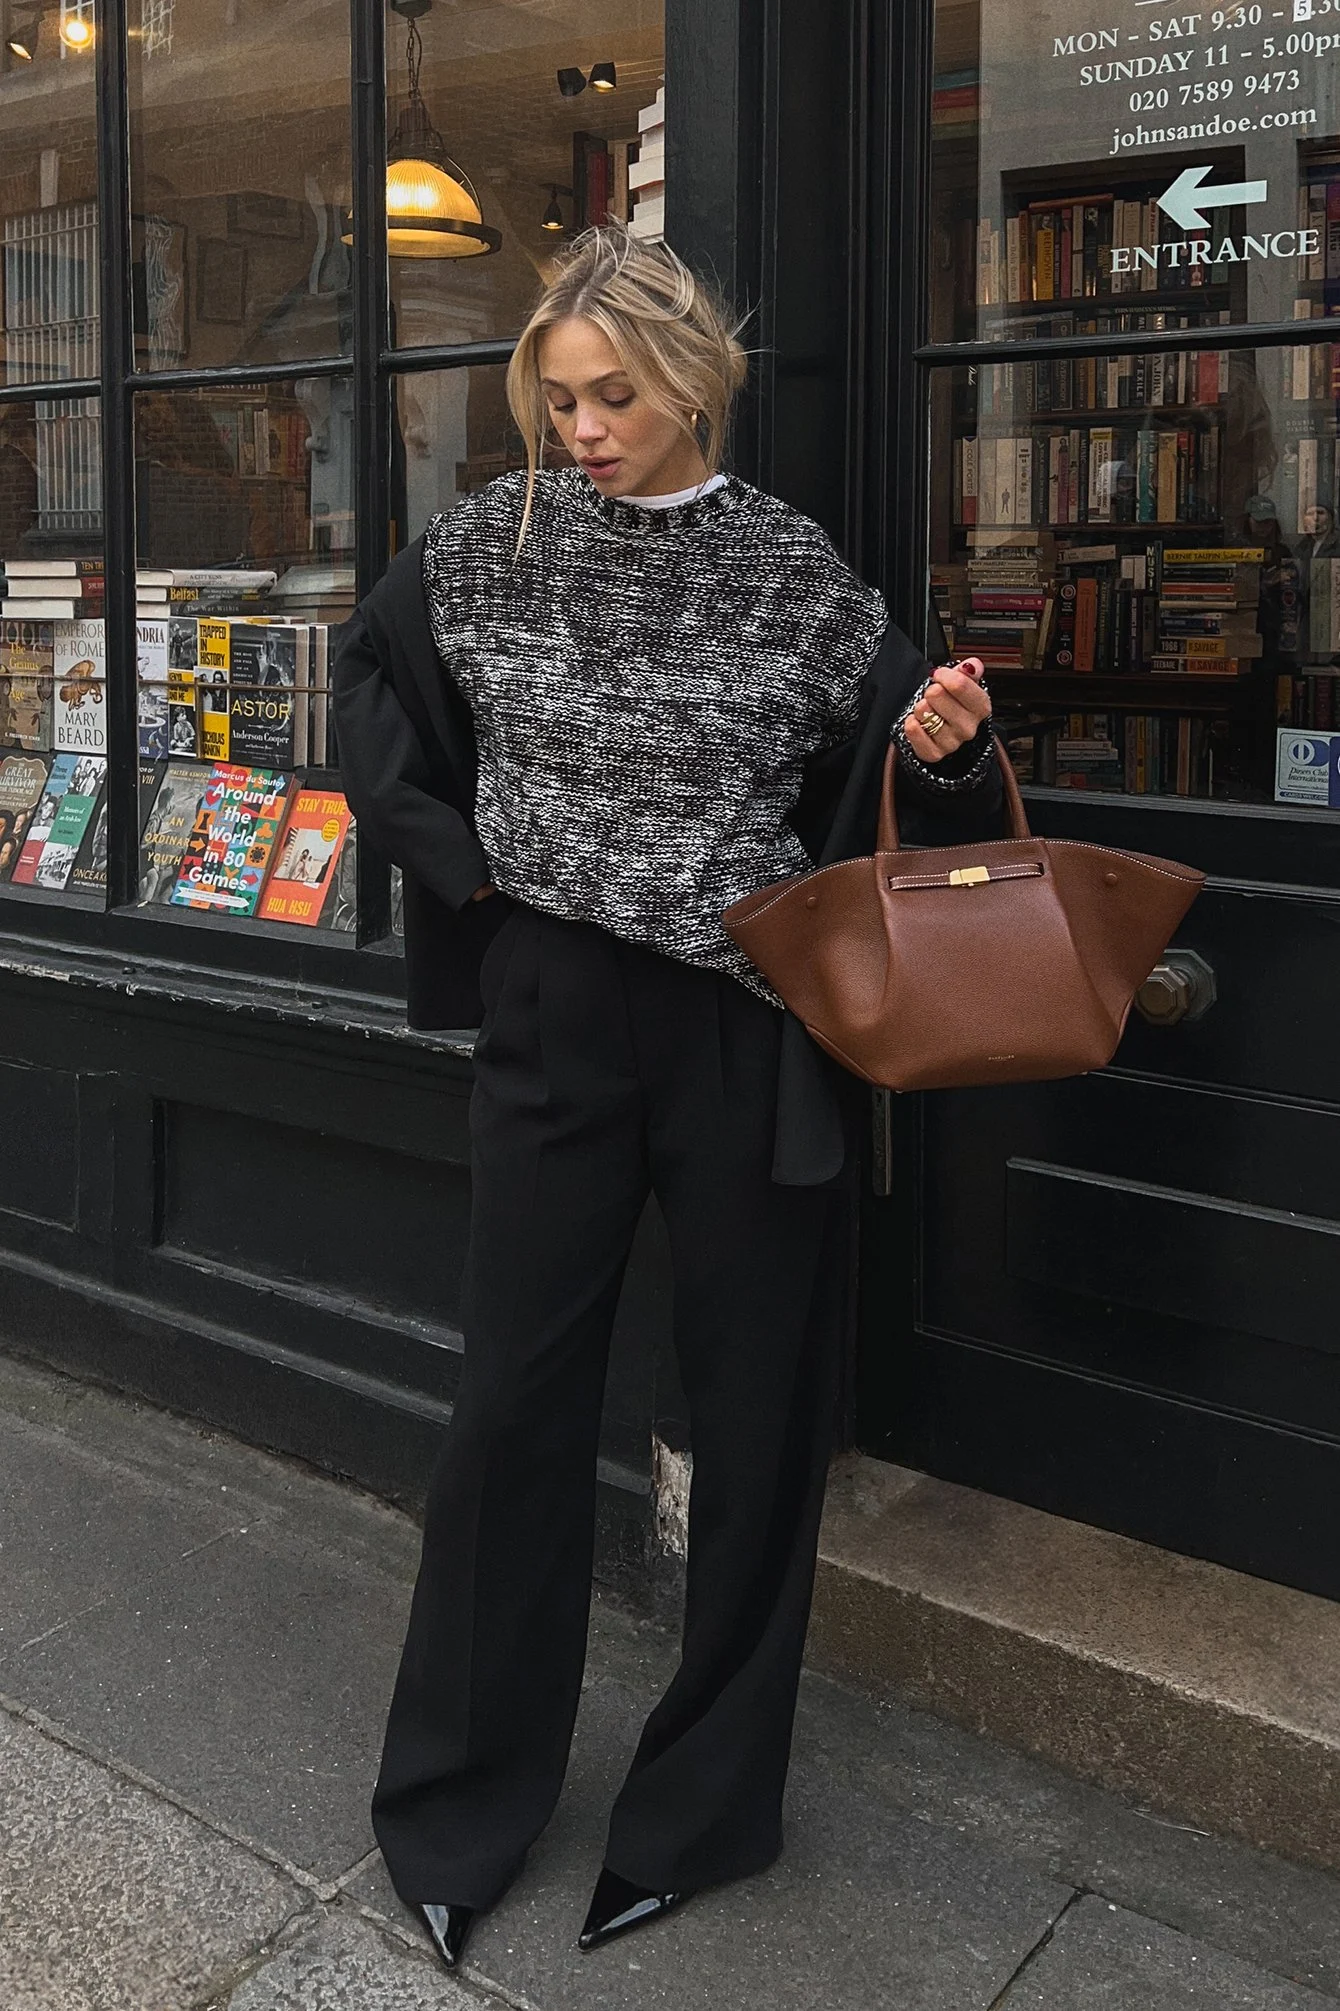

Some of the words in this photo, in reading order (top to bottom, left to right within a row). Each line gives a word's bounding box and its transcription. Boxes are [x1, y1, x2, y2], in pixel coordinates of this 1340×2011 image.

[1052, 28, 1119, 57] MON
[1149, 14, 1202, 41] SAT
[1211, 4, 1262, 31] 9.30
[1297, 0, 1340, 16] 5.3
[1079, 50, 1194, 86] SUNDAY
[1204, 45, 1229, 67] 11
[1262, 31, 1340, 60] 5.00p
[1129, 88, 1169, 112] 020
[1178, 78, 1233, 105] 7589
[1243, 69, 1300, 97] 9473
[1109, 108, 1318, 155] johnsandoe.com
[1043, 231, 1052, 280] BEETHOVEN
[1109, 229, 1320, 273] ENTRANCE
[1136, 369, 1144, 398] EXILE
[1152, 367, 1162, 397] JOHN
[81, 561, 93, 570] TEN
[169, 587, 199, 600] Belfast
[55, 623, 105, 638] EMPEROR
[200, 624, 226, 640] TRAPPED
[10, 642, 25, 655] The
[55, 644, 68, 656] OF
[70, 640, 104, 657] ROME
[200, 639, 208, 651] IN
[1194, 641, 1219, 652] SAVAGE
[9, 657, 40, 670] Genius
[200, 652, 226, 667] HISTORY
[1153, 660, 1176, 669] TEENAGE
[1197, 660, 1229, 672] SAVAGE
[10, 688, 25, 703] Age
[231, 699, 290, 720] ASTOR
[64, 711, 97, 726] MARY
[58, 727, 104, 746] BEARD
[231, 729, 264, 742] Anderson
[264, 732, 290, 746] Cooper
[5, 766, 34, 778] GREAT
[142, 774, 155, 785] VIII
[214, 770, 244, 782] Marcus
[245, 775, 256, 784] du
[258, 776, 285, 789] Sautoy
[1288, 774, 1328, 783] Internationa
[1290, 767, 1311, 775] Diners
[1313, 768, 1328, 776] Club
[0, 776, 37, 789] URVIVOR
[212, 783, 278, 805] Around
[224, 806, 251, 824] the
[296, 798, 320, 813] STAY
[321, 799, 348, 816] TRUE
[169, 816, 184, 826] AN
[144, 833, 190, 847] ORDINAR
[208, 824, 257, 847] World
[147, 852, 182, 865] YOUTH
[203, 845, 219, 863] in
[223, 850, 246, 867] 80
[73, 868, 94, 880] ONCE
[188, 866, 248, 891] Games
[267, 897, 286, 913] HUA
[288, 899, 312, 917] HSU
